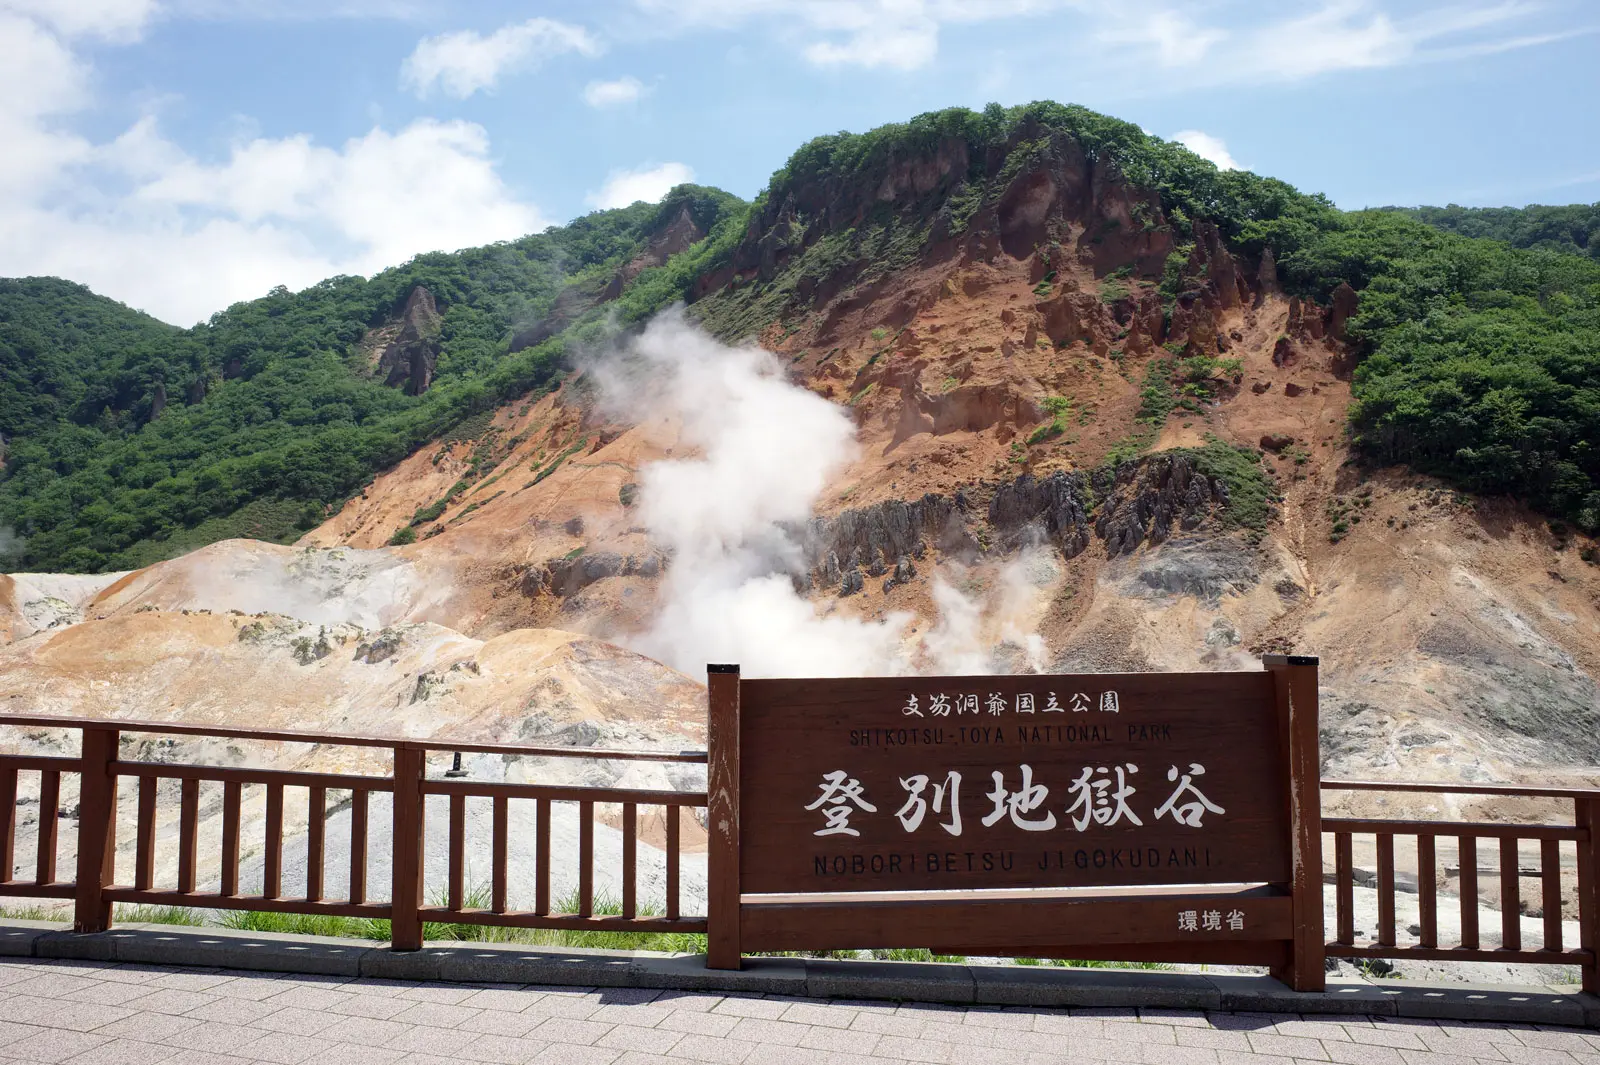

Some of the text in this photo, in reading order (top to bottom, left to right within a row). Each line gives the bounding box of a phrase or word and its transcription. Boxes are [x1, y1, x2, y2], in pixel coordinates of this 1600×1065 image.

[901, 690, 1120, 718] 支笏洞爺国立公園
[850, 723, 1173, 746] SHIKOTSU-TOYA NATIONAL PARK
[804, 763, 1226, 837] 登別地獄谷
[814, 848, 1211, 876] NOBORIBETSU JIGOKUDANI
[1178, 909, 1245, 932] 環境省
